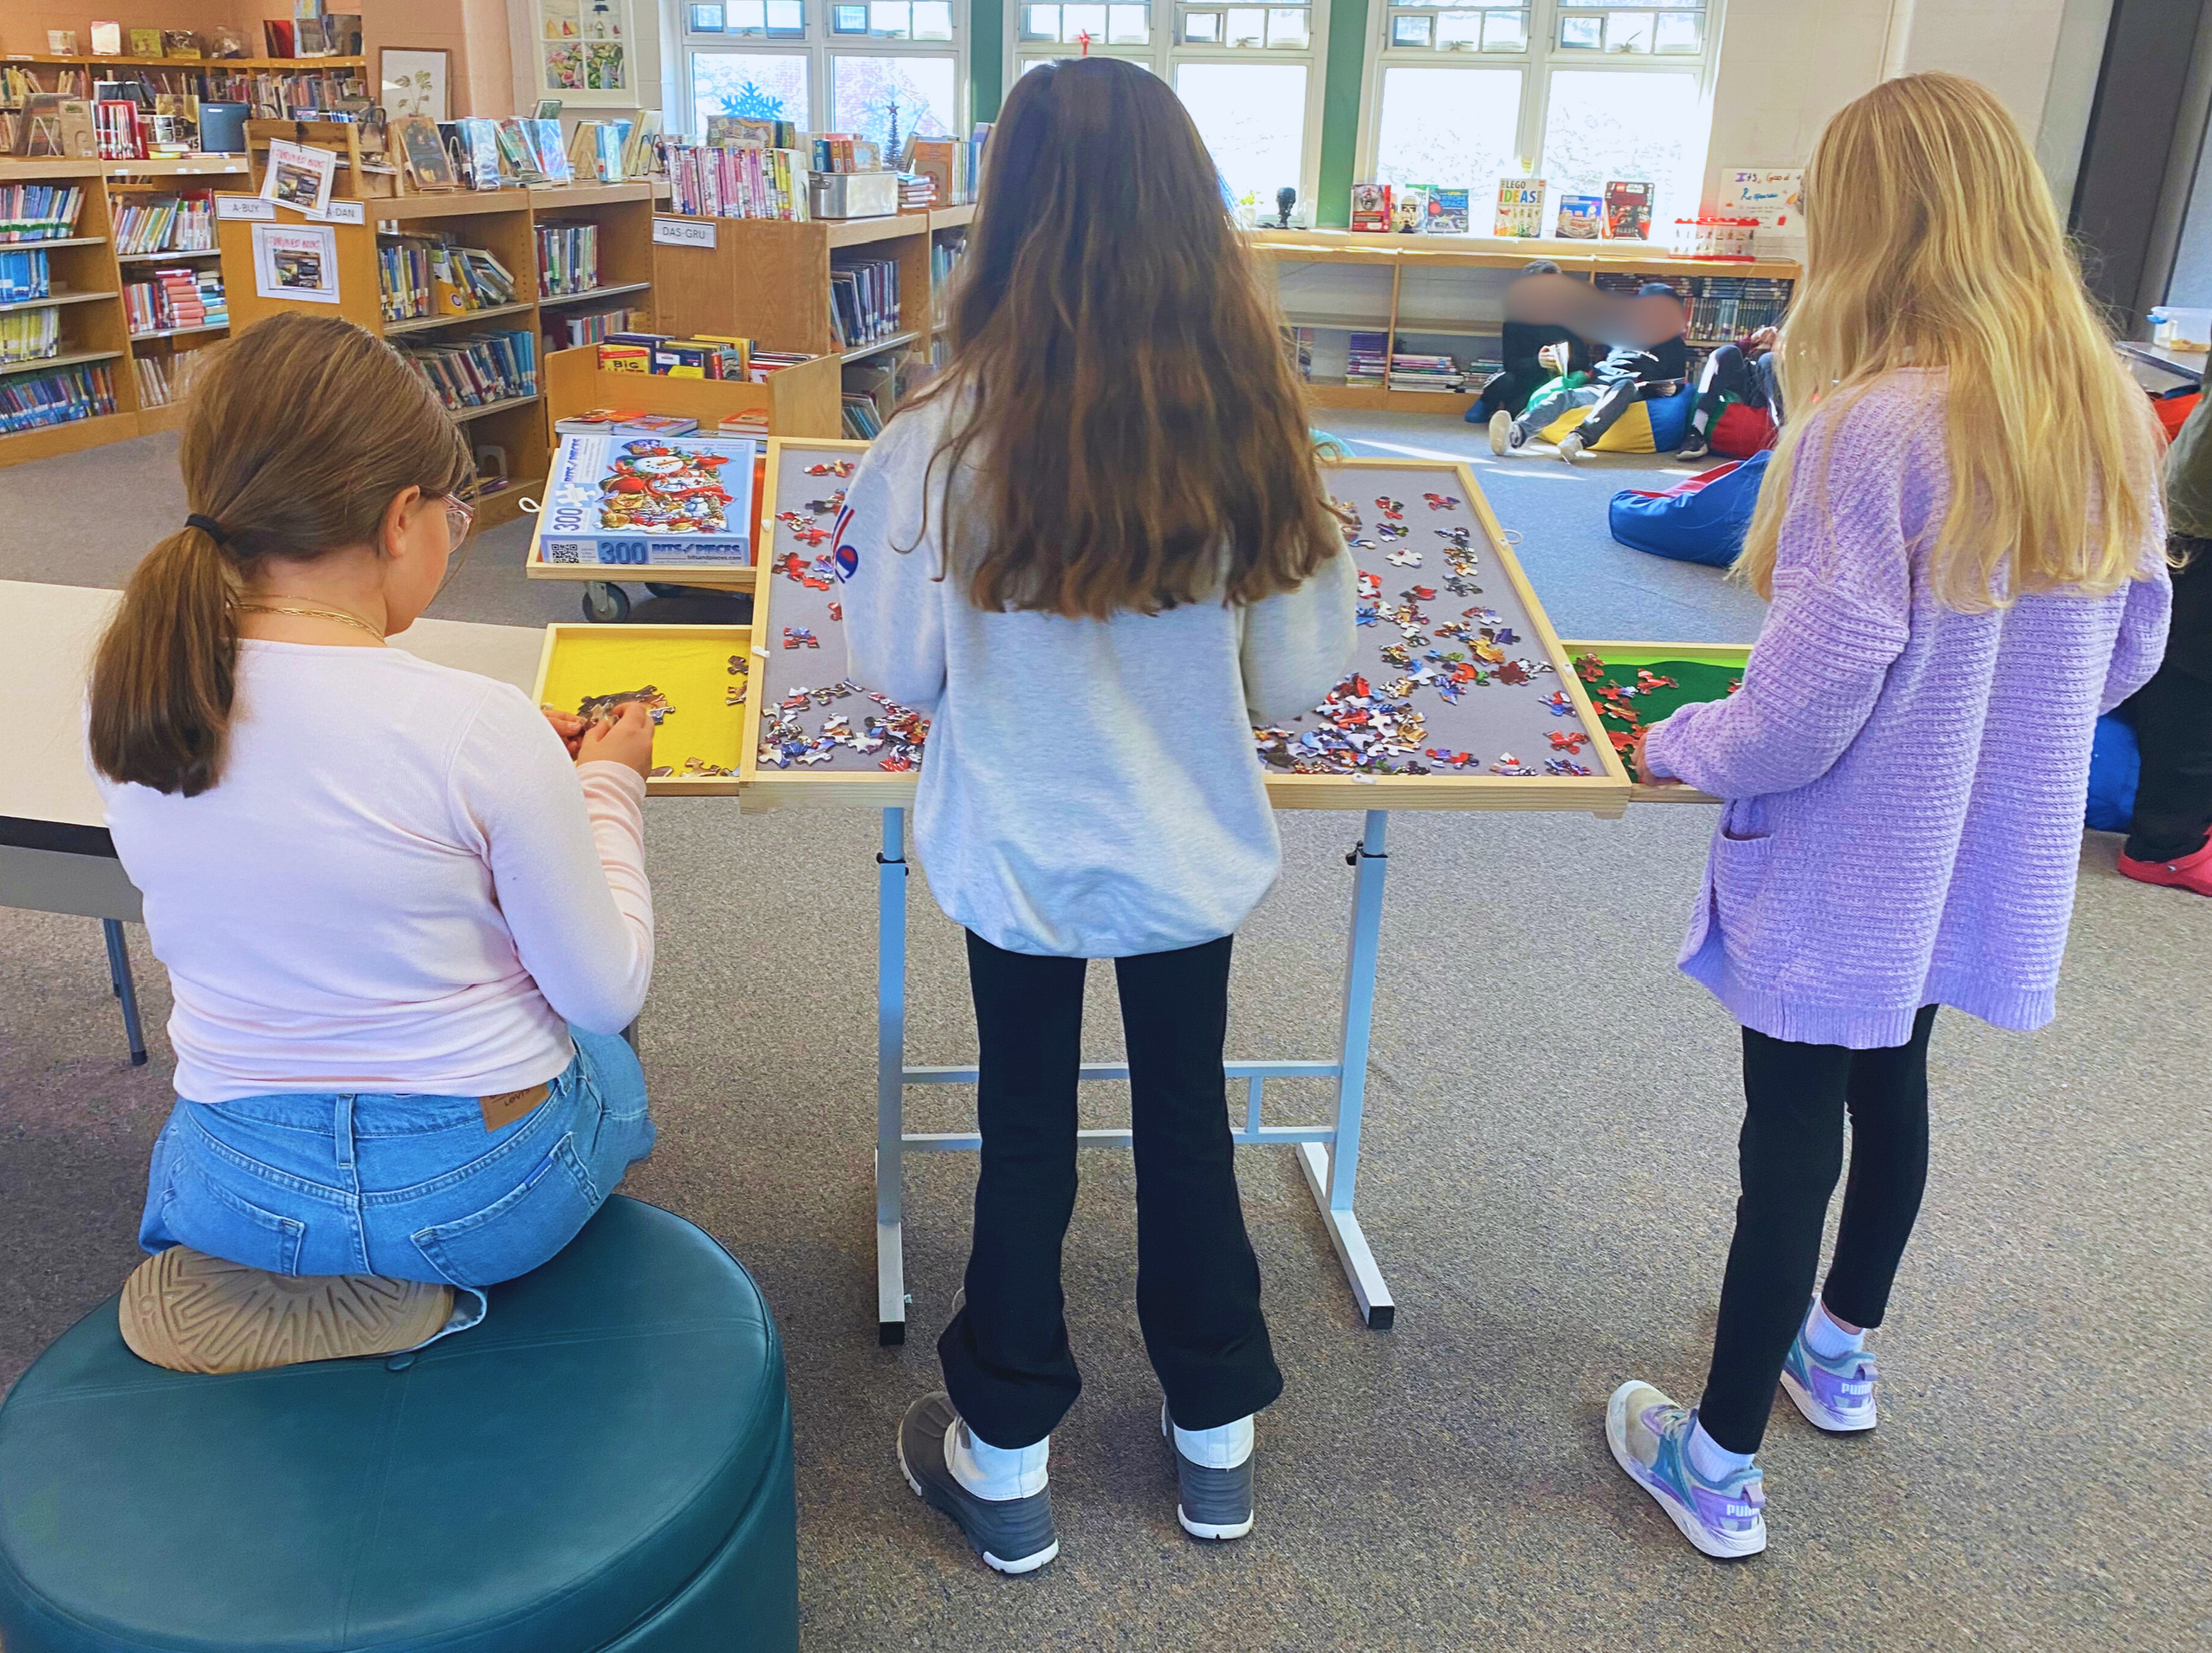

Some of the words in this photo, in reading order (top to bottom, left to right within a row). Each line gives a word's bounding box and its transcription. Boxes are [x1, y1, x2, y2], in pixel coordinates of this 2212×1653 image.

[1766, 172, 1791, 184] Good
[1506, 180, 1526, 189] LEGO
[1499, 189, 1536, 203] IDEAS
[232, 203, 260, 213] A-BUY
[662, 226, 706, 239] DAS-GRU
[451, 295, 462, 306] C
[553, 508, 583, 531] 300
[600, 541, 646, 564] 300
[652, 543, 683, 554] BITS
[696, 544, 742, 554] PIECES
